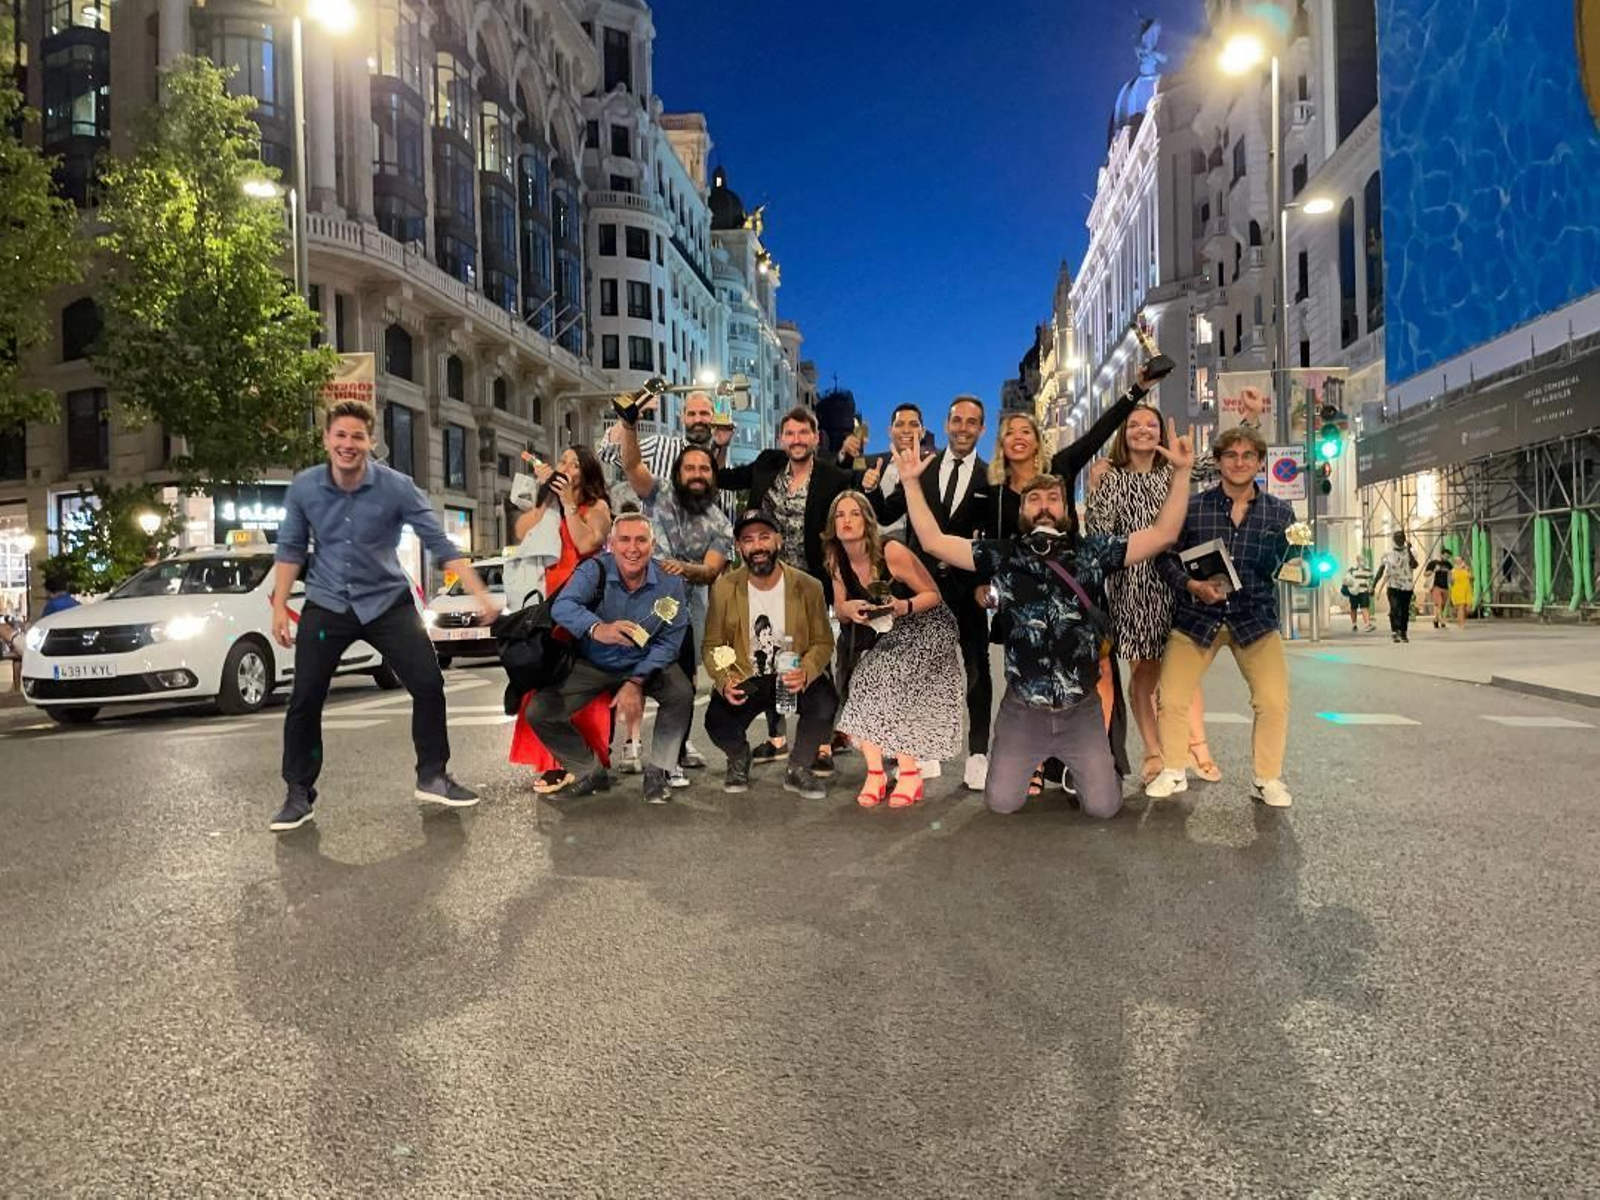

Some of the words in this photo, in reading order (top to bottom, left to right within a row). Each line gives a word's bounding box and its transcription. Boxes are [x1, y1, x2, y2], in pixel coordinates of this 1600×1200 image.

[1544, 375, 1580, 392] COMERCIAL
[61, 665, 87, 677] 4391
[91, 664, 113, 676] KYL
